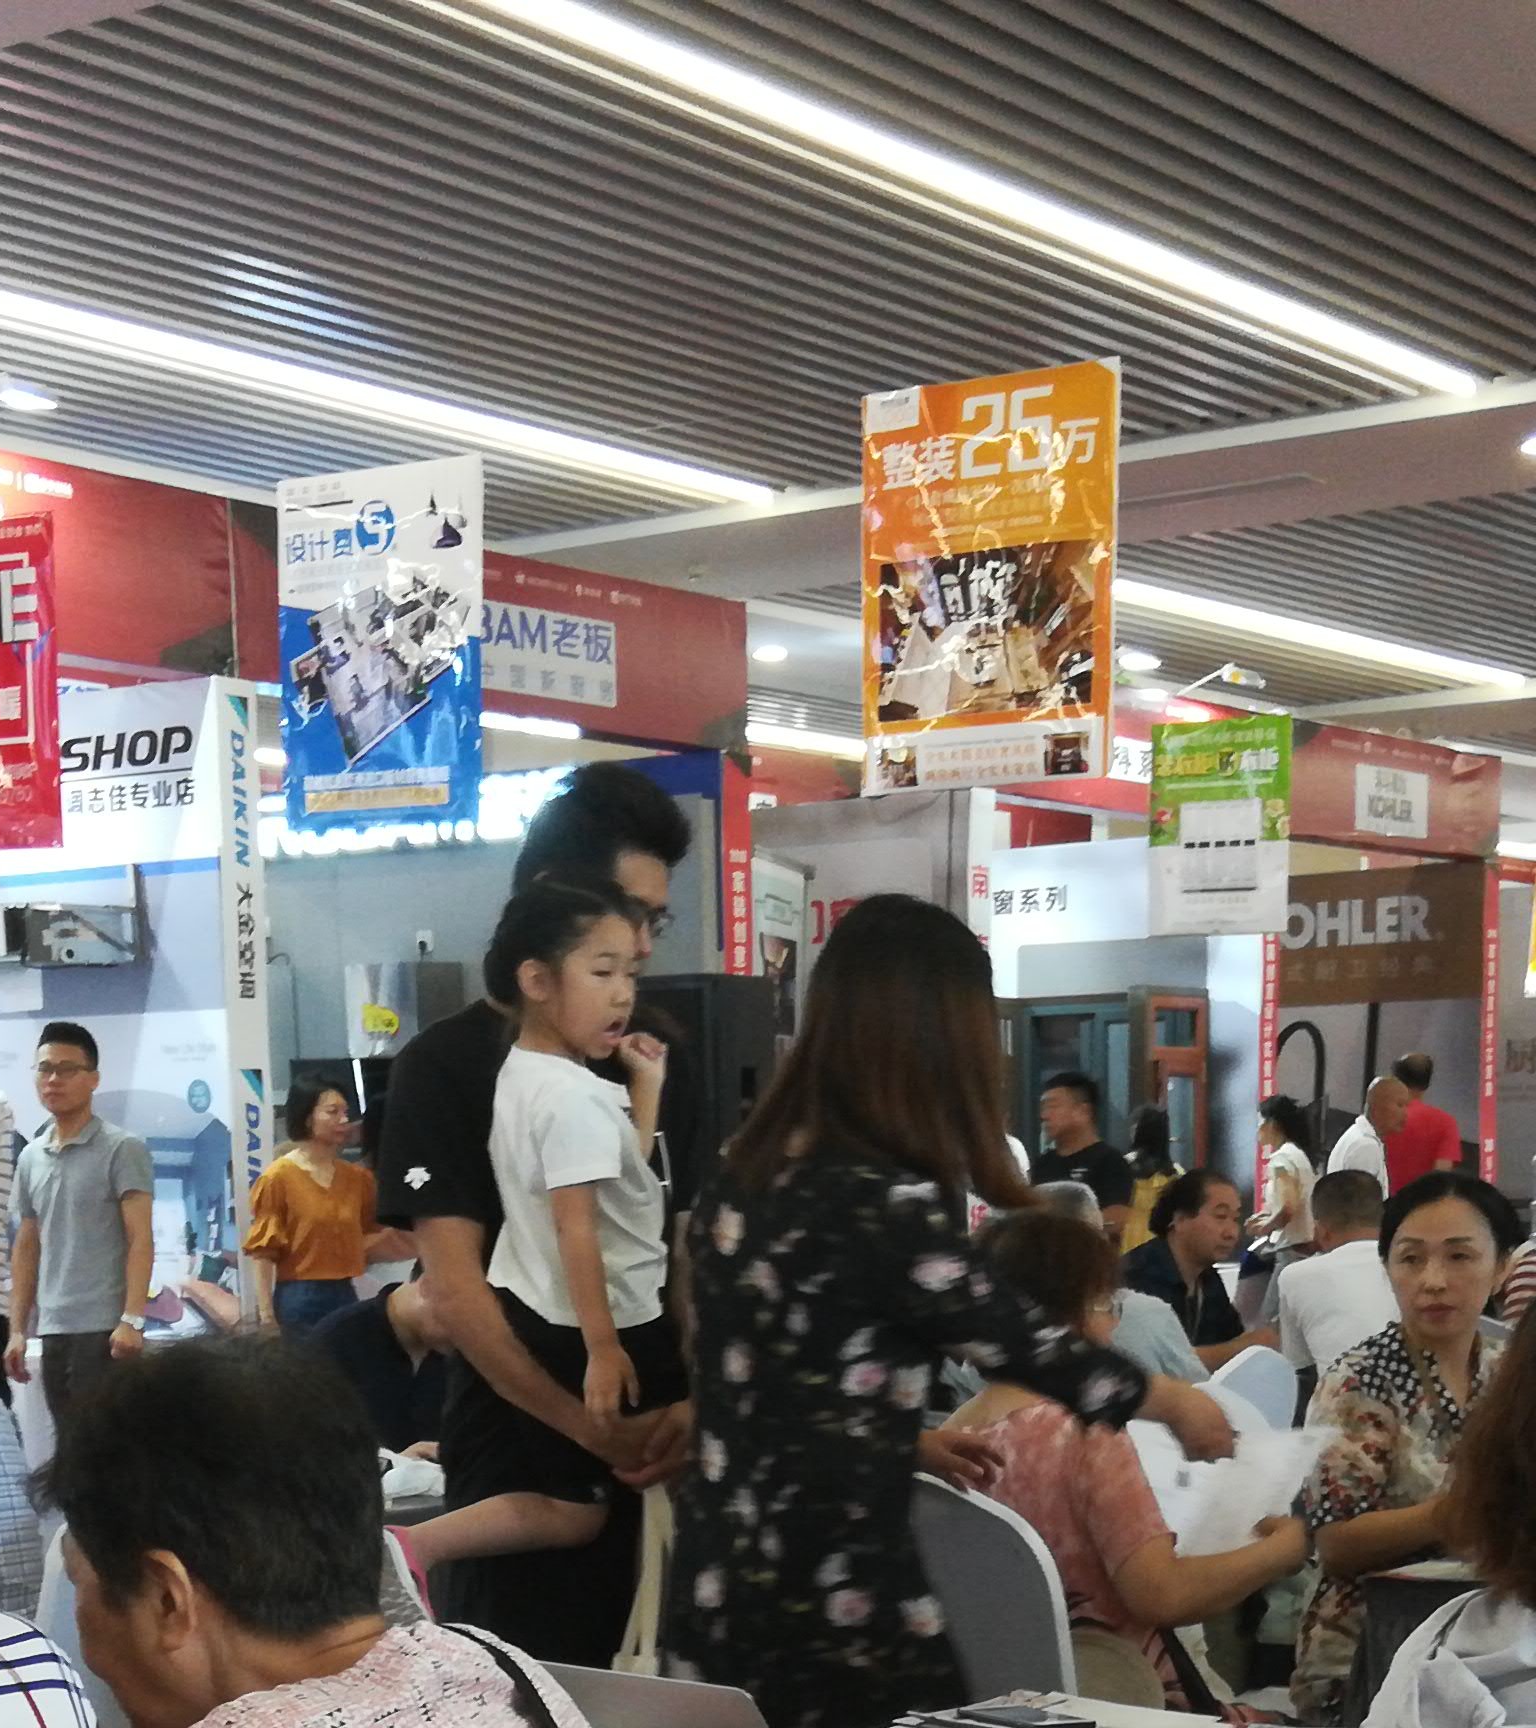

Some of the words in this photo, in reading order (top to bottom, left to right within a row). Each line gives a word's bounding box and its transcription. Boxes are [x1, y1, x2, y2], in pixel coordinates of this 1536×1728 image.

[60, 726, 194, 773] SHOP
[230, 729, 251, 868] DAIKIN
[235, 882, 257, 1000] 大金空调
